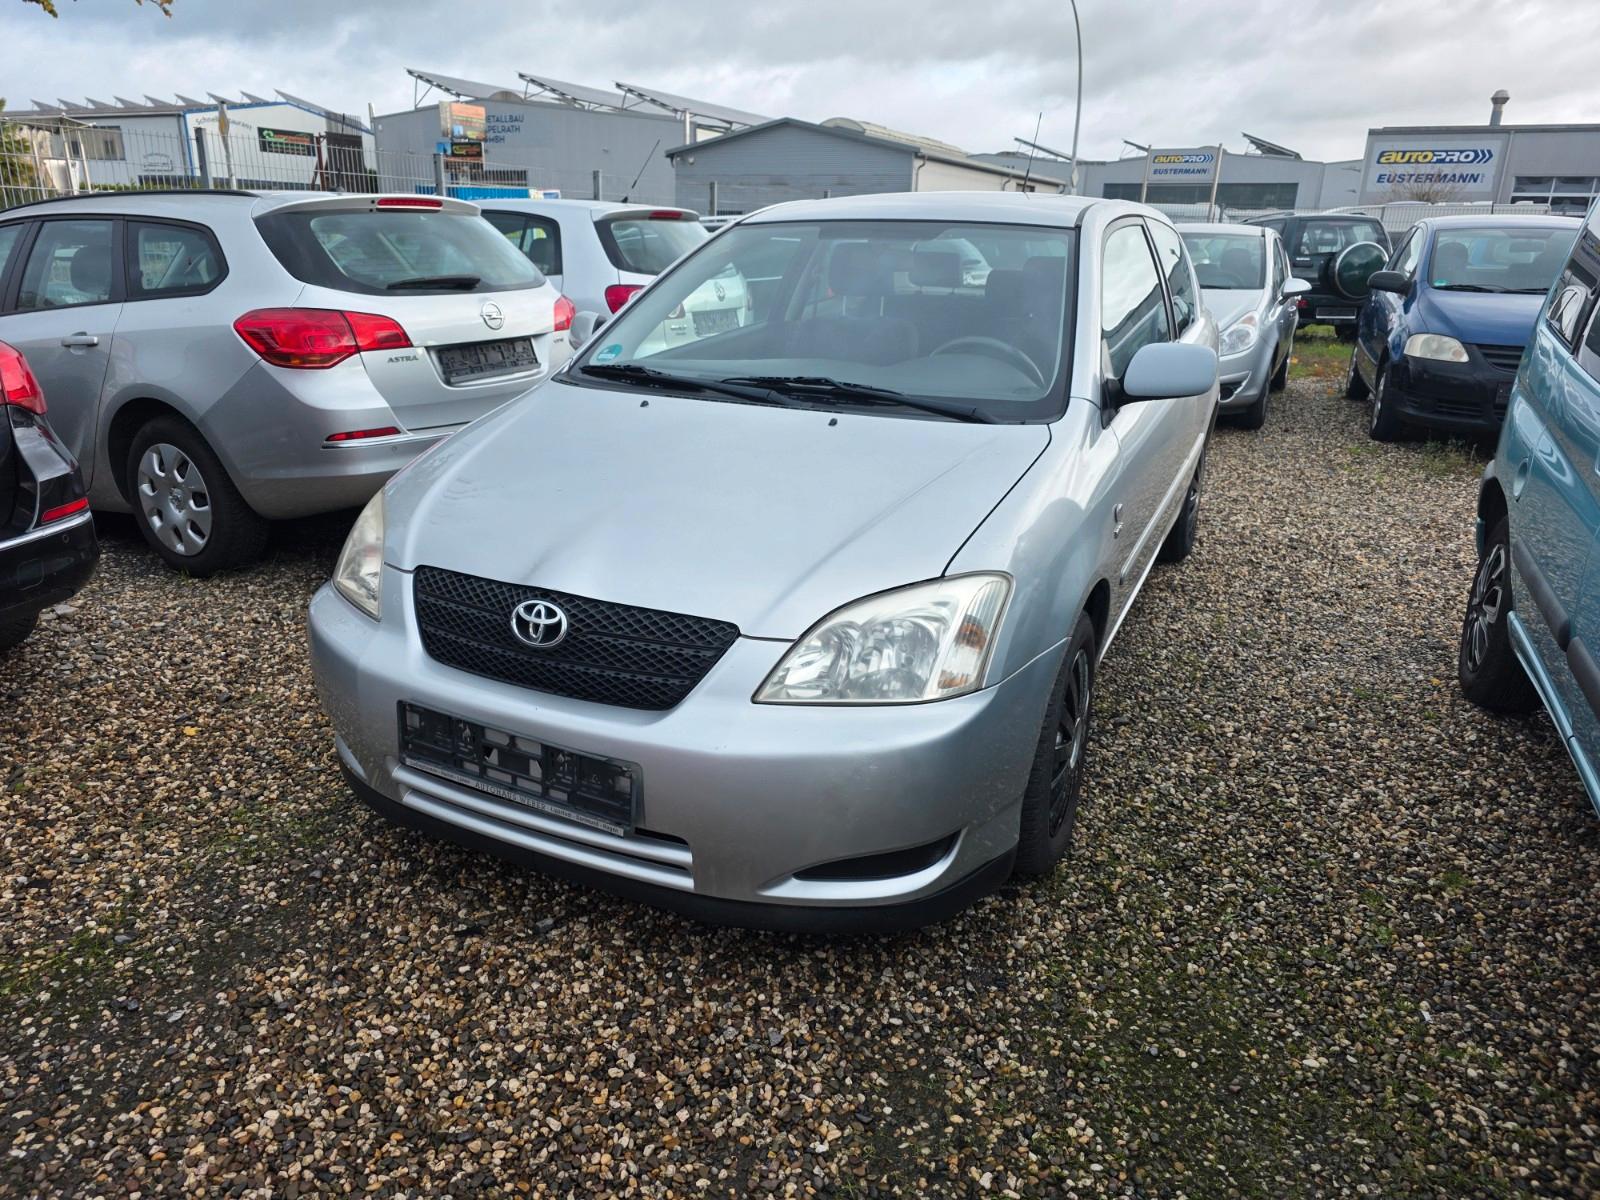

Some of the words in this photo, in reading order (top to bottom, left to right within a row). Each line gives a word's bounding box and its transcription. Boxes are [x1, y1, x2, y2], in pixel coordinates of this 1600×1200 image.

[487, 114, 524, 123] ETALLBAU
[487, 125, 521, 134] PELRATH
[1376, 173, 1482, 184] EUSTERMANN
[387, 355, 419, 363] ASTRA
